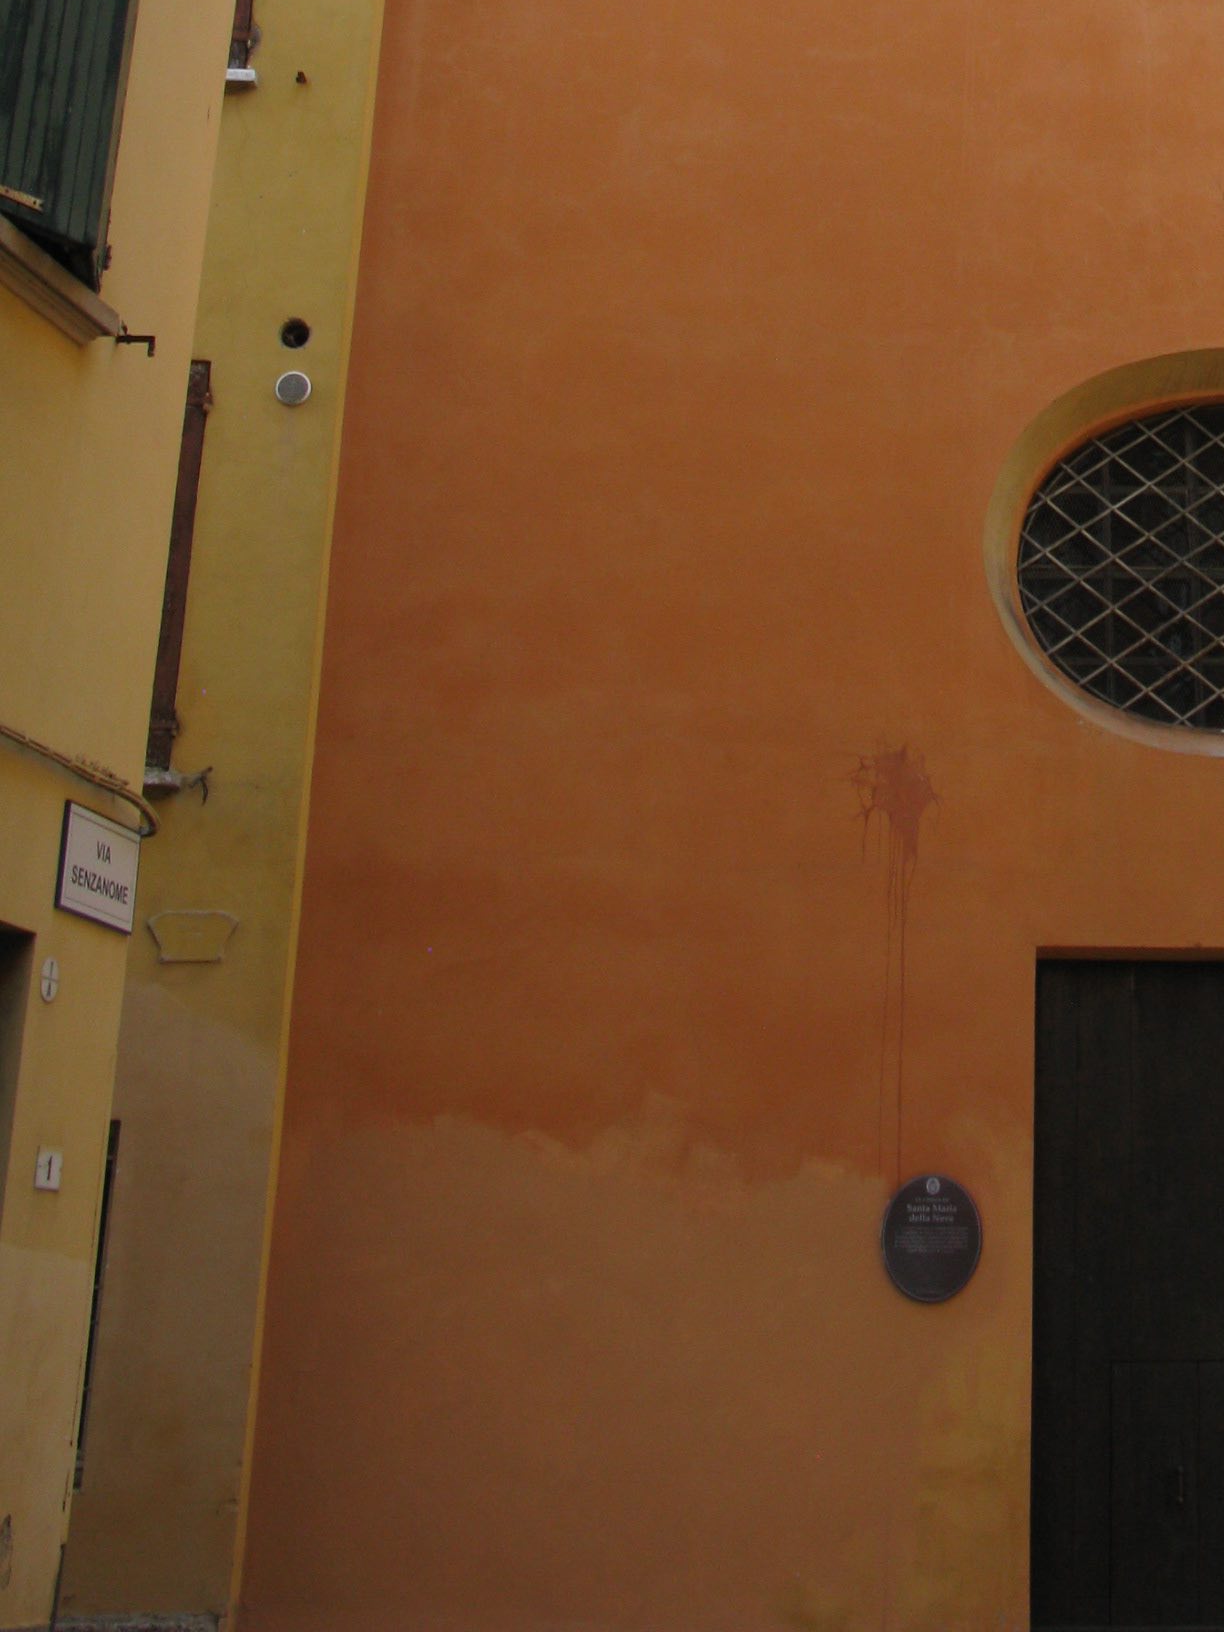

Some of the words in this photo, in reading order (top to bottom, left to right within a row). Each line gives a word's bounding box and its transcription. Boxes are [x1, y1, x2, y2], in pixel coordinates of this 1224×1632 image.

[96, 841, 112, 864] VIA
[71, 864, 129, 905] SENZANOME
[46, 1154, 53, 1181] 1
